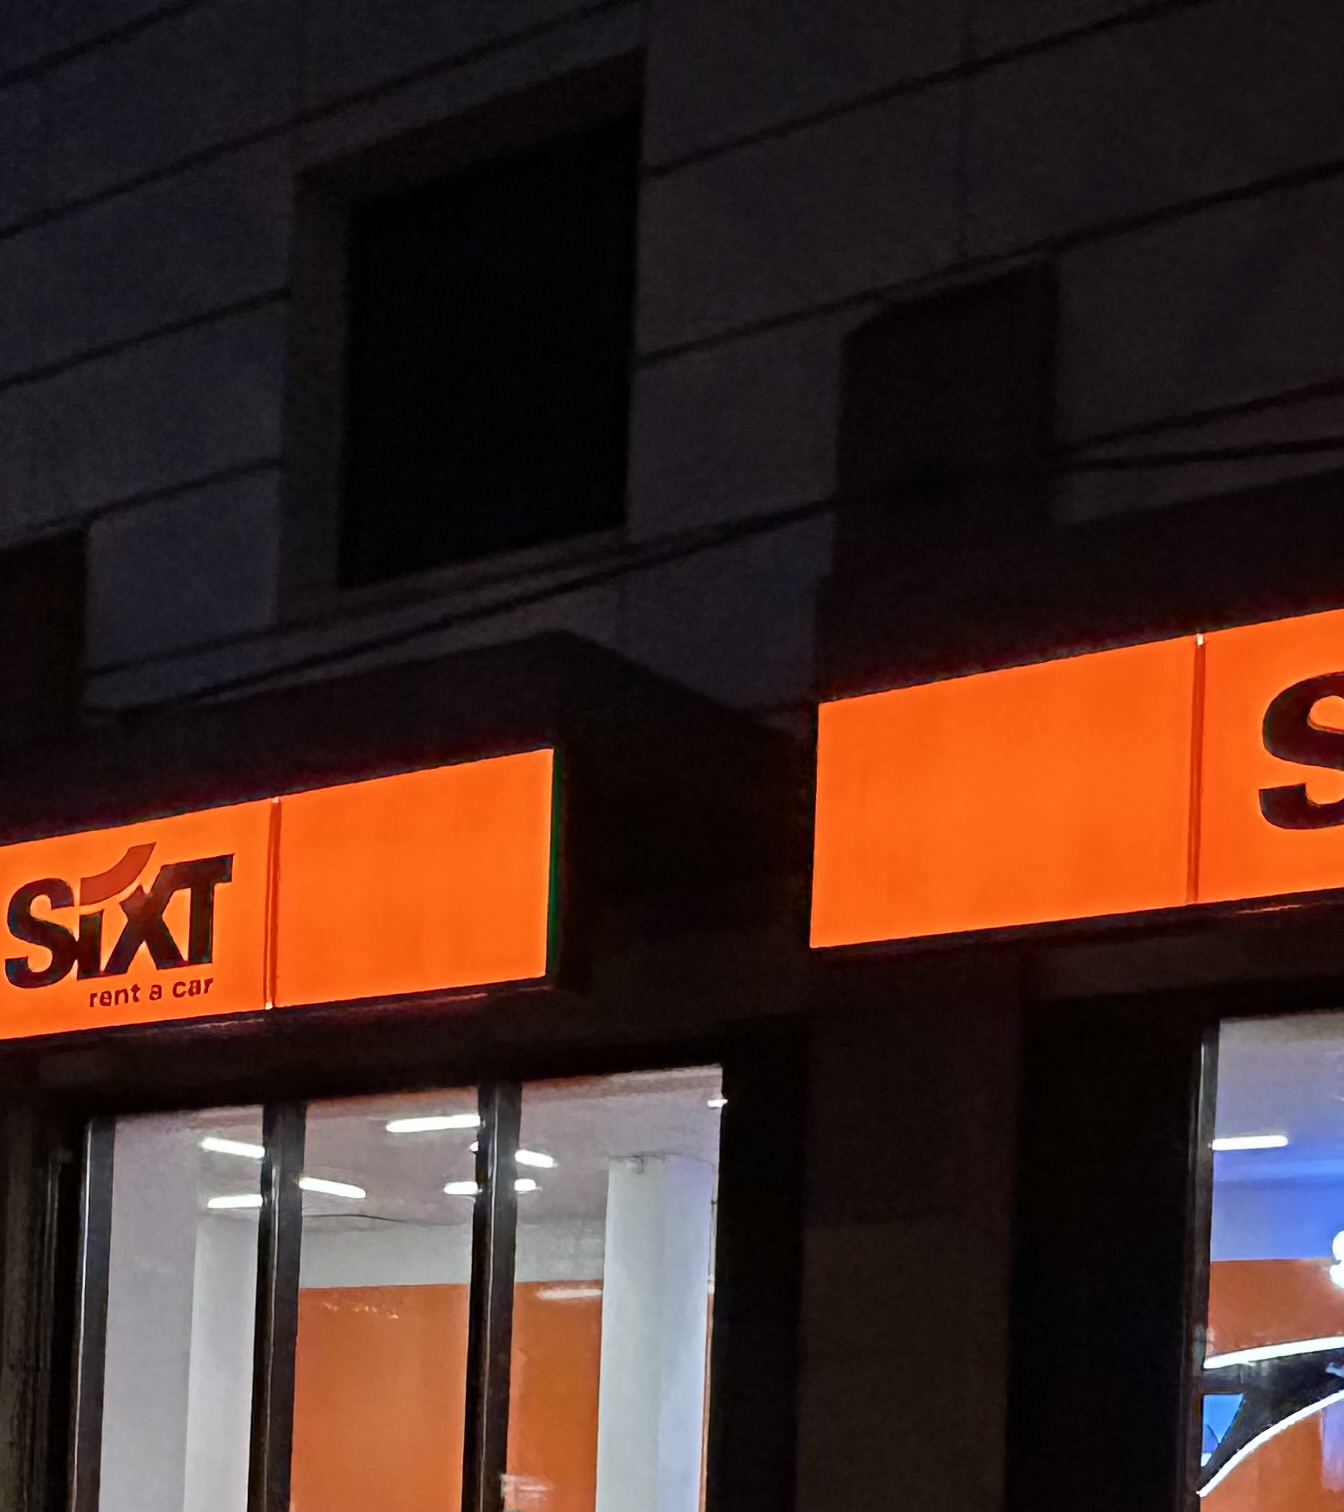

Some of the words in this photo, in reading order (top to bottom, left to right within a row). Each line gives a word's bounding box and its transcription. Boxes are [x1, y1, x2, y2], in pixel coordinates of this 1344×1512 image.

[89, 983, 142, 1008] rent
[148, 984, 163, 1001] a
[172, 978, 215, 998] car
